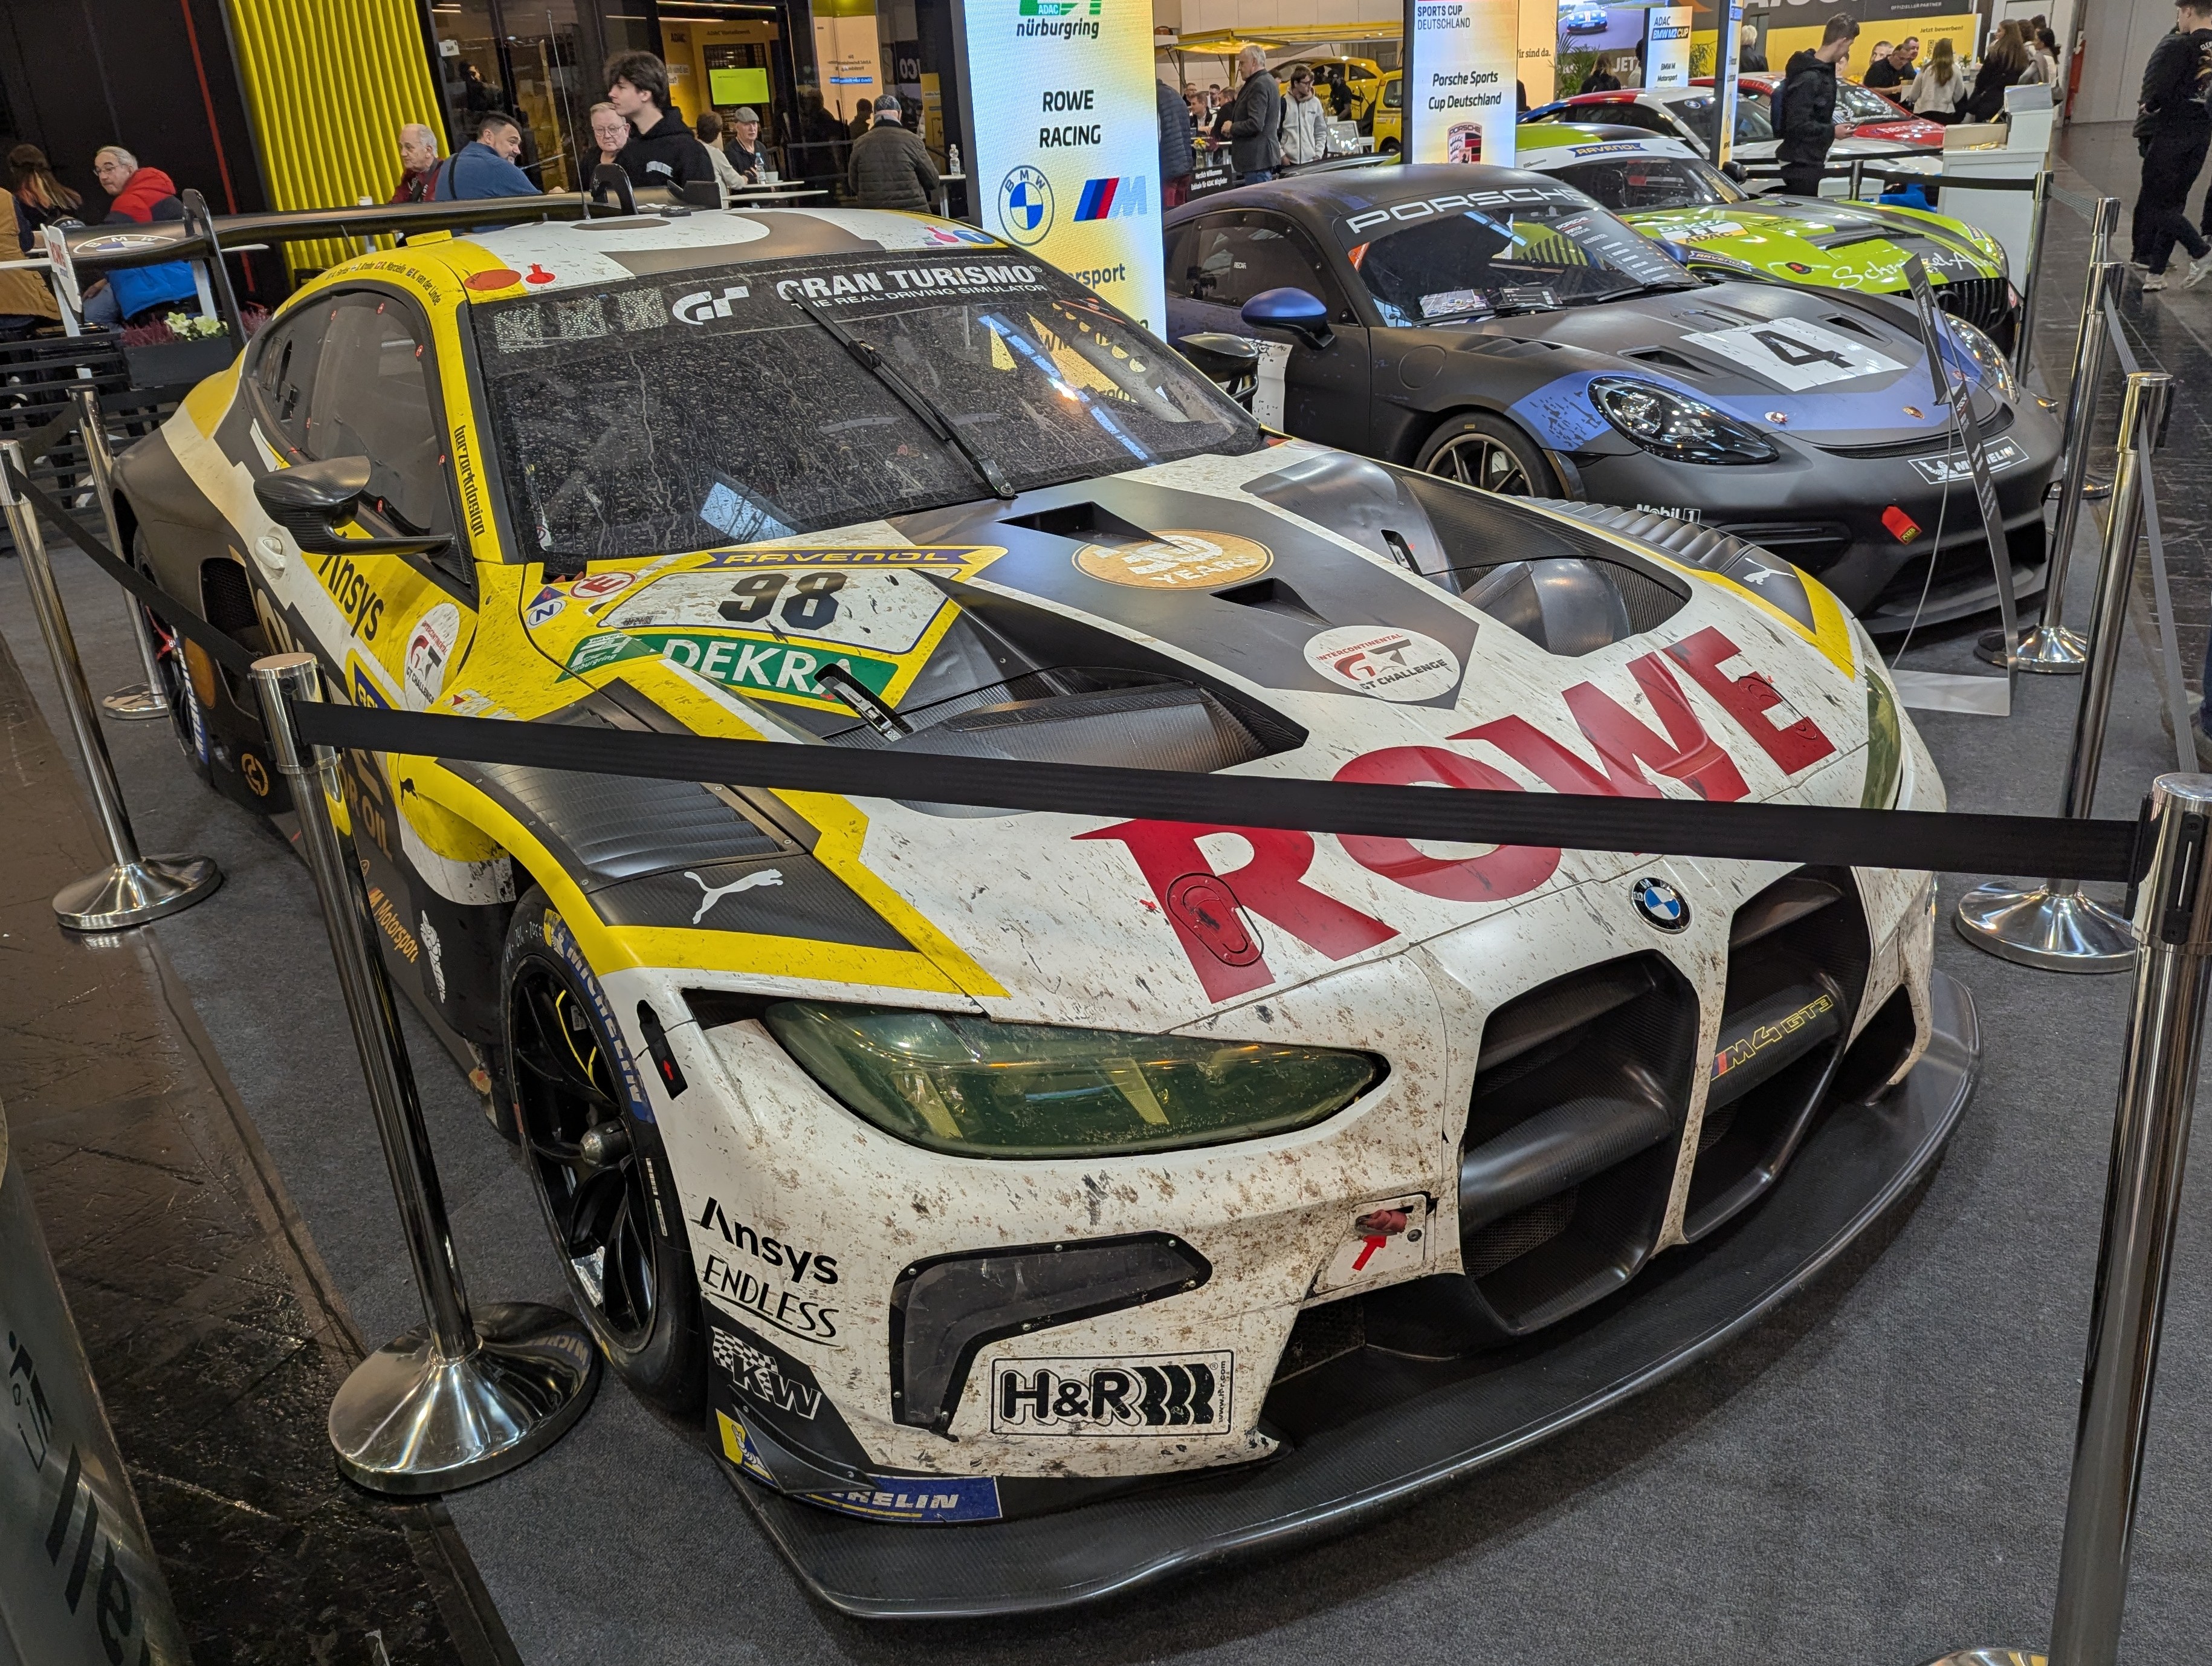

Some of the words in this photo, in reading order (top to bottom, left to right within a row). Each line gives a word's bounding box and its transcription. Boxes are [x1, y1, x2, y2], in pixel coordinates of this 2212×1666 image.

[1038, 4, 1059, 15] ADAC
[1418, 6, 1446, 16] SPORTS
[1448, 5, 1463, 16] CUP
[1654, 16, 1671, 26] ADAC
[1016, 18, 1099, 39] nürburgring
[1417, 18, 1470, 30] DEUTSCHLAND
[1653, 29, 1668, 39] BMW
[1677, 28, 1689, 37] CUP
[1525, 48, 1540, 57] sind
[1541, 48, 1551, 57] da.
[1432, 72, 1468, 86] Porsche
[1470, 71, 1498, 86] Sports
[1043, 89, 1094, 112] ROWE
[1429, 96, 1445, 112] Cup
[1447, 92, 1502, 108] Deutschland
[1040, 125, 1101, 147] RACING
[1449, 124, 1481, 136] PORSCHE
[1576, 144, 1640, 155] RAVENOL
[1005, 169, 1046, 193] BMW
[1345, 187, 1589, 234] PORSCHE
[1657, 219, 1722, 233] DEKRA
[1683, 227, 1718, 237] 11
[1685, 232, 1733, 244] ADAC
[428, 284, 442, 306] Linde
[776, 271, 884, 302] GRAN
[888, 265, 1036, 289] TURISMO
[835, 294, 880, 306] REAL
[885, 288, 957, 300] DRIVING
[959, 284, 1049, 295] SIMULATOR
[1751, 329, 1855, 369] 4
[454, 424, 486, 539] berzerkdesign
[1903, 528, 1916, 541] OMP
[722, 552, 949, 565] RAVENOL
[1148, 555, 1260, 585] YEARS
[717, 572, 849, 630] 98
[421, 620, 448, 656] INTERCONTINENTAL
[1316, 632, 1403, 661] INTERCONTINENTAL
[662, 638, 853, 695] DEKRA
[1359, 681, 1377, 690] GT
[1379, 658, 1447, 686] CHALLENGE
[406, 666, 413, 678] GT
[412, 672, 435, 705] CHALLENGE
[1071, 625, 1837, 1004] ROWE
[374, 899, 419, 964] Motorsport
[566, 945, 641, 1103] MICHELIN
[1727, 1026, 1782, 1071] M4
[1780, 994, 1834, 1034] GT3
[699, 1196, 839, 1285] Ansys
[703, 1254, 839, 1338] ENDLESS
[731, 1351, 823, 1421] KW
[999, 1369, 1145, 1427] H&R
[832, 1489, 959, 1509] HELIN
